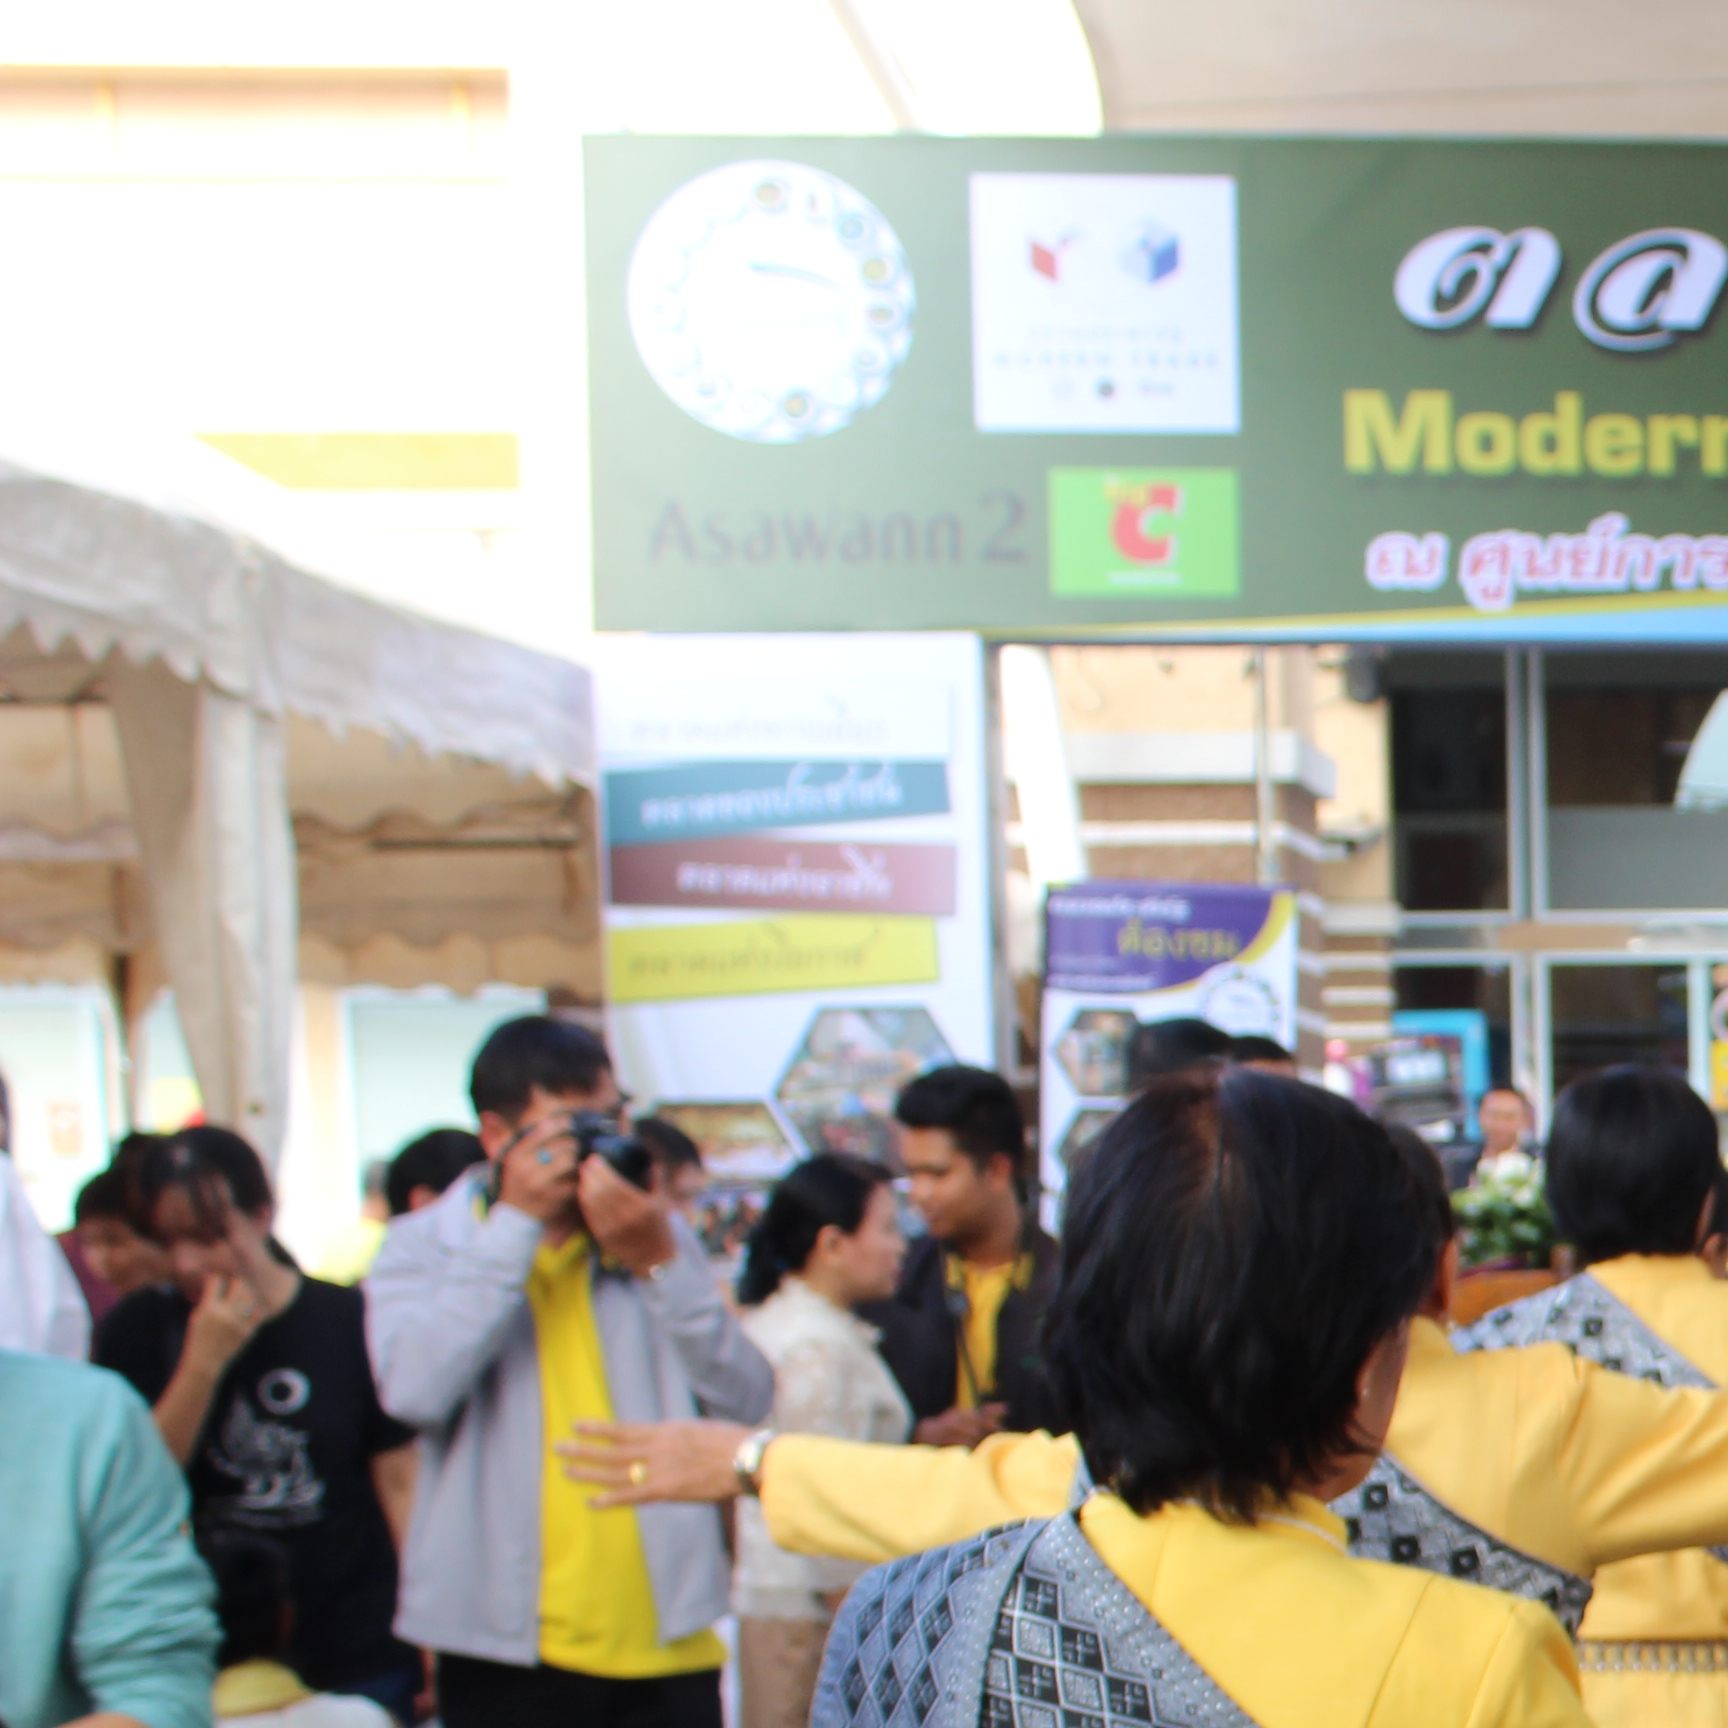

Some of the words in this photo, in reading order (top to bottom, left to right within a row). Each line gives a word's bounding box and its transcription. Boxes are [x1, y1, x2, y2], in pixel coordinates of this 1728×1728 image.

[648, 498, 966, 567] Asawann
[977, 487, 1031, 567] 2
[1365, 530, 1449, 591] ณ
